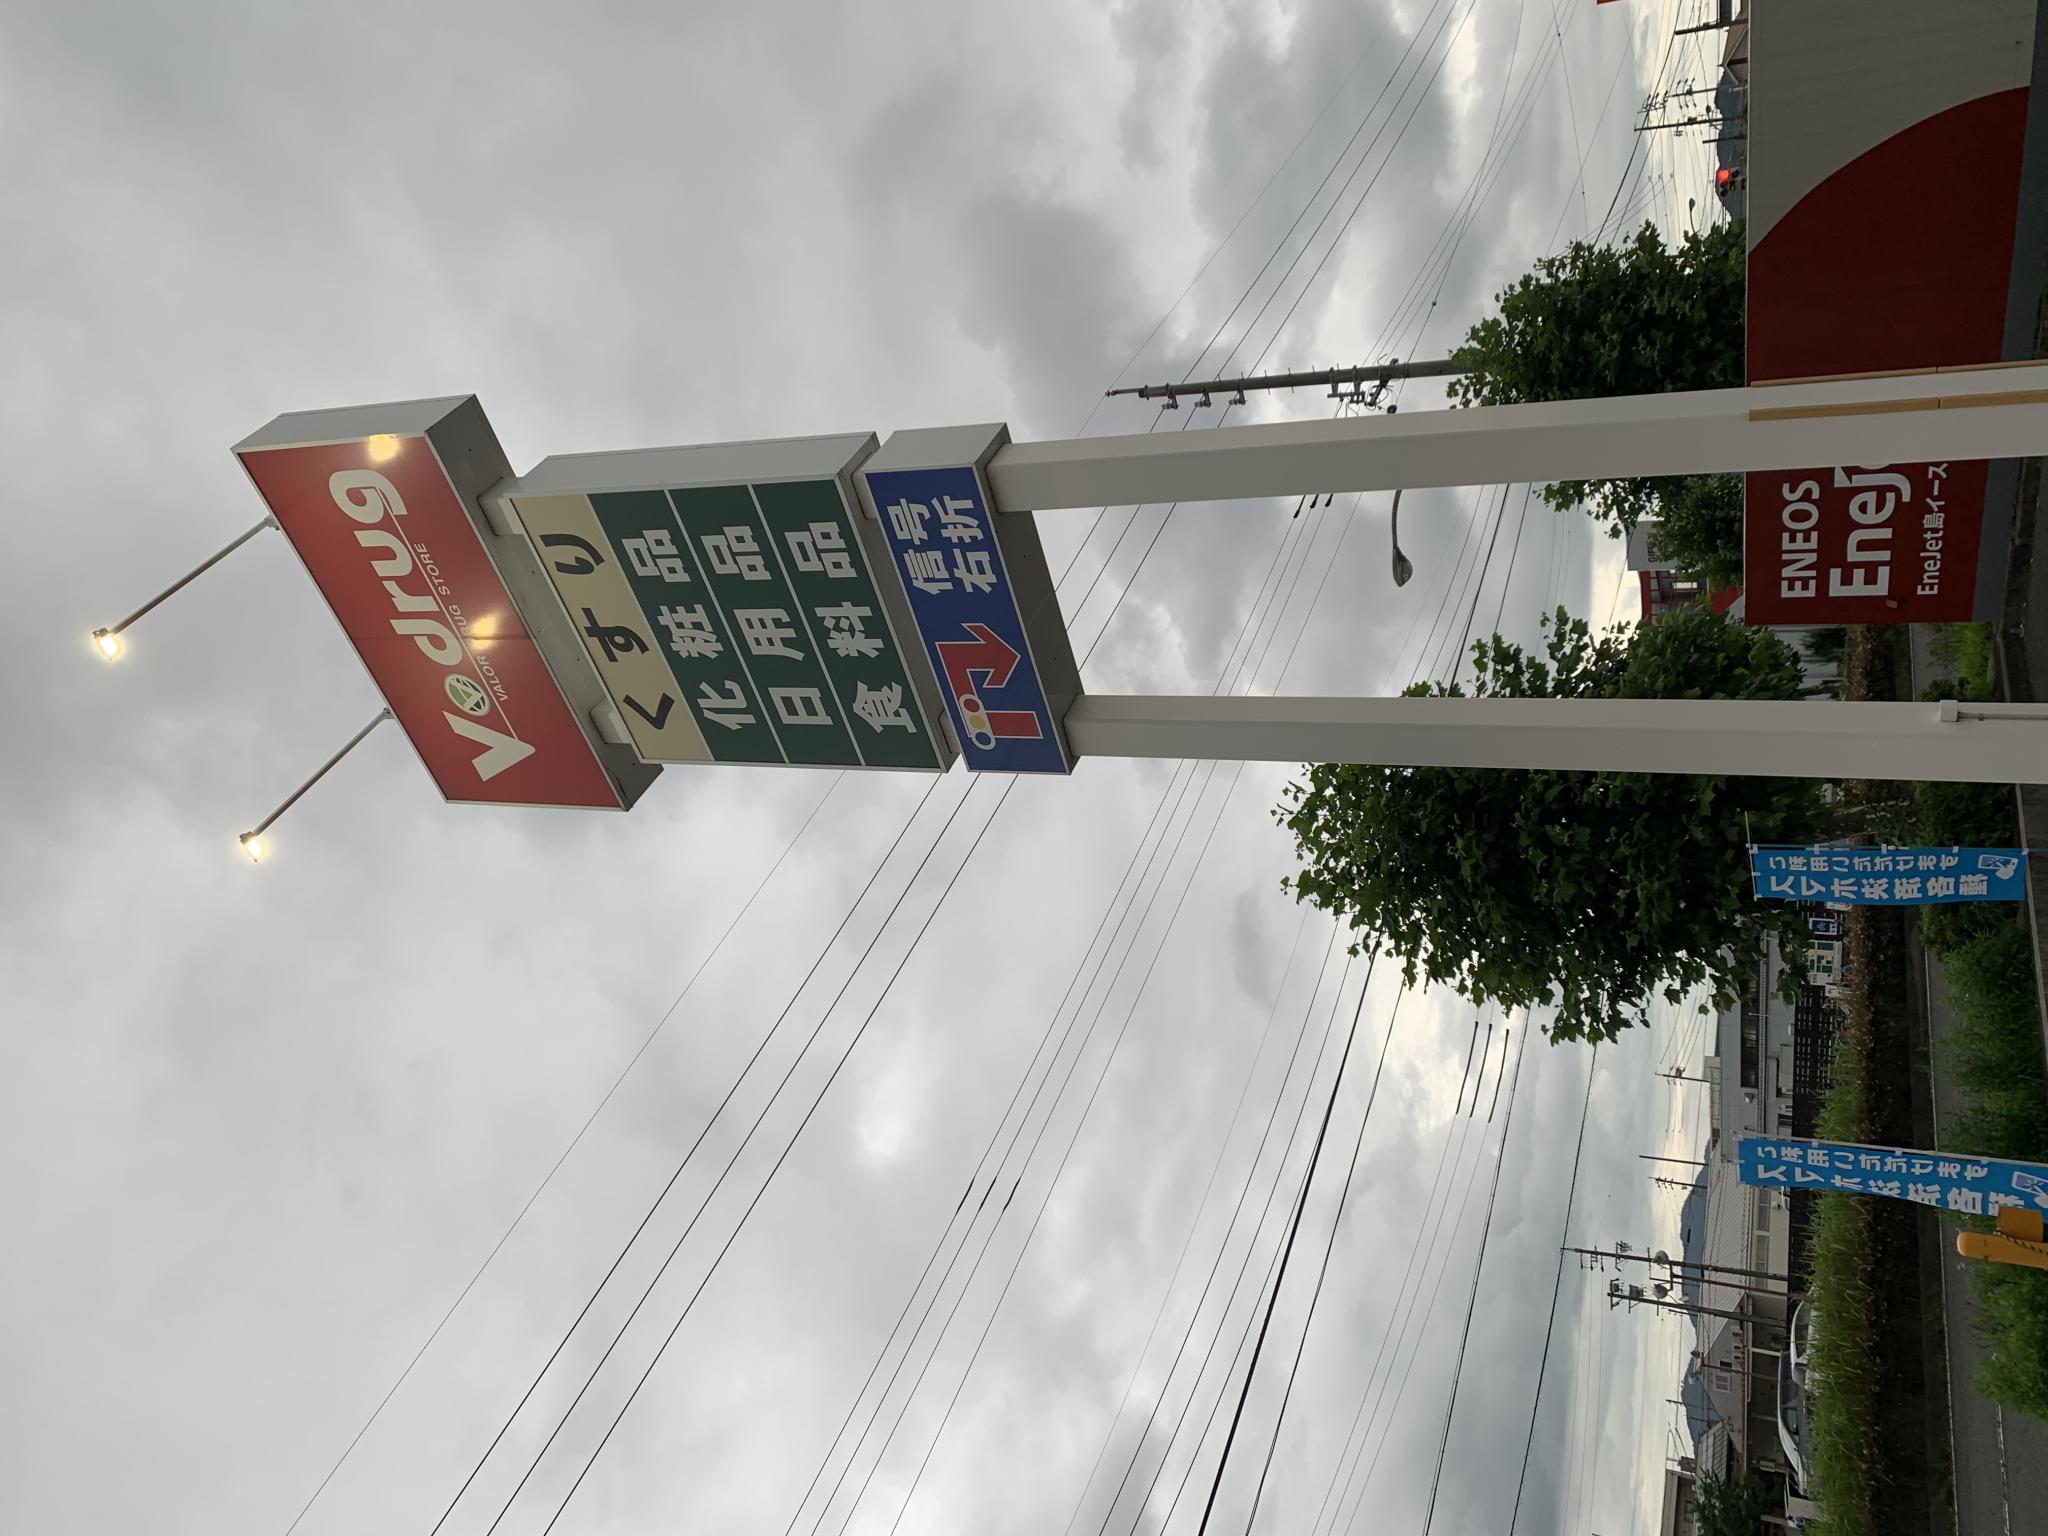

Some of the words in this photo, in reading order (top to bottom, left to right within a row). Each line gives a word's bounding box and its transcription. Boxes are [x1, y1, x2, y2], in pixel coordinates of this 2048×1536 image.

[413, 542, 450, 595] STORE
[887, 497, 953, 595] 信号
[931, 495, 998, 594] 右折
[1780, 480, 1820, 598] ENEOS
[1916, 462, 1948, 595] EneJet島イース
[476, 655, 509, 702] VALOR
[539, 533, 675, 730] くすり
[621, 529, 756, 731] 化粧品
[700, 525, 834, 725] 日用品
[784, 521, 917, 733] 食料品
